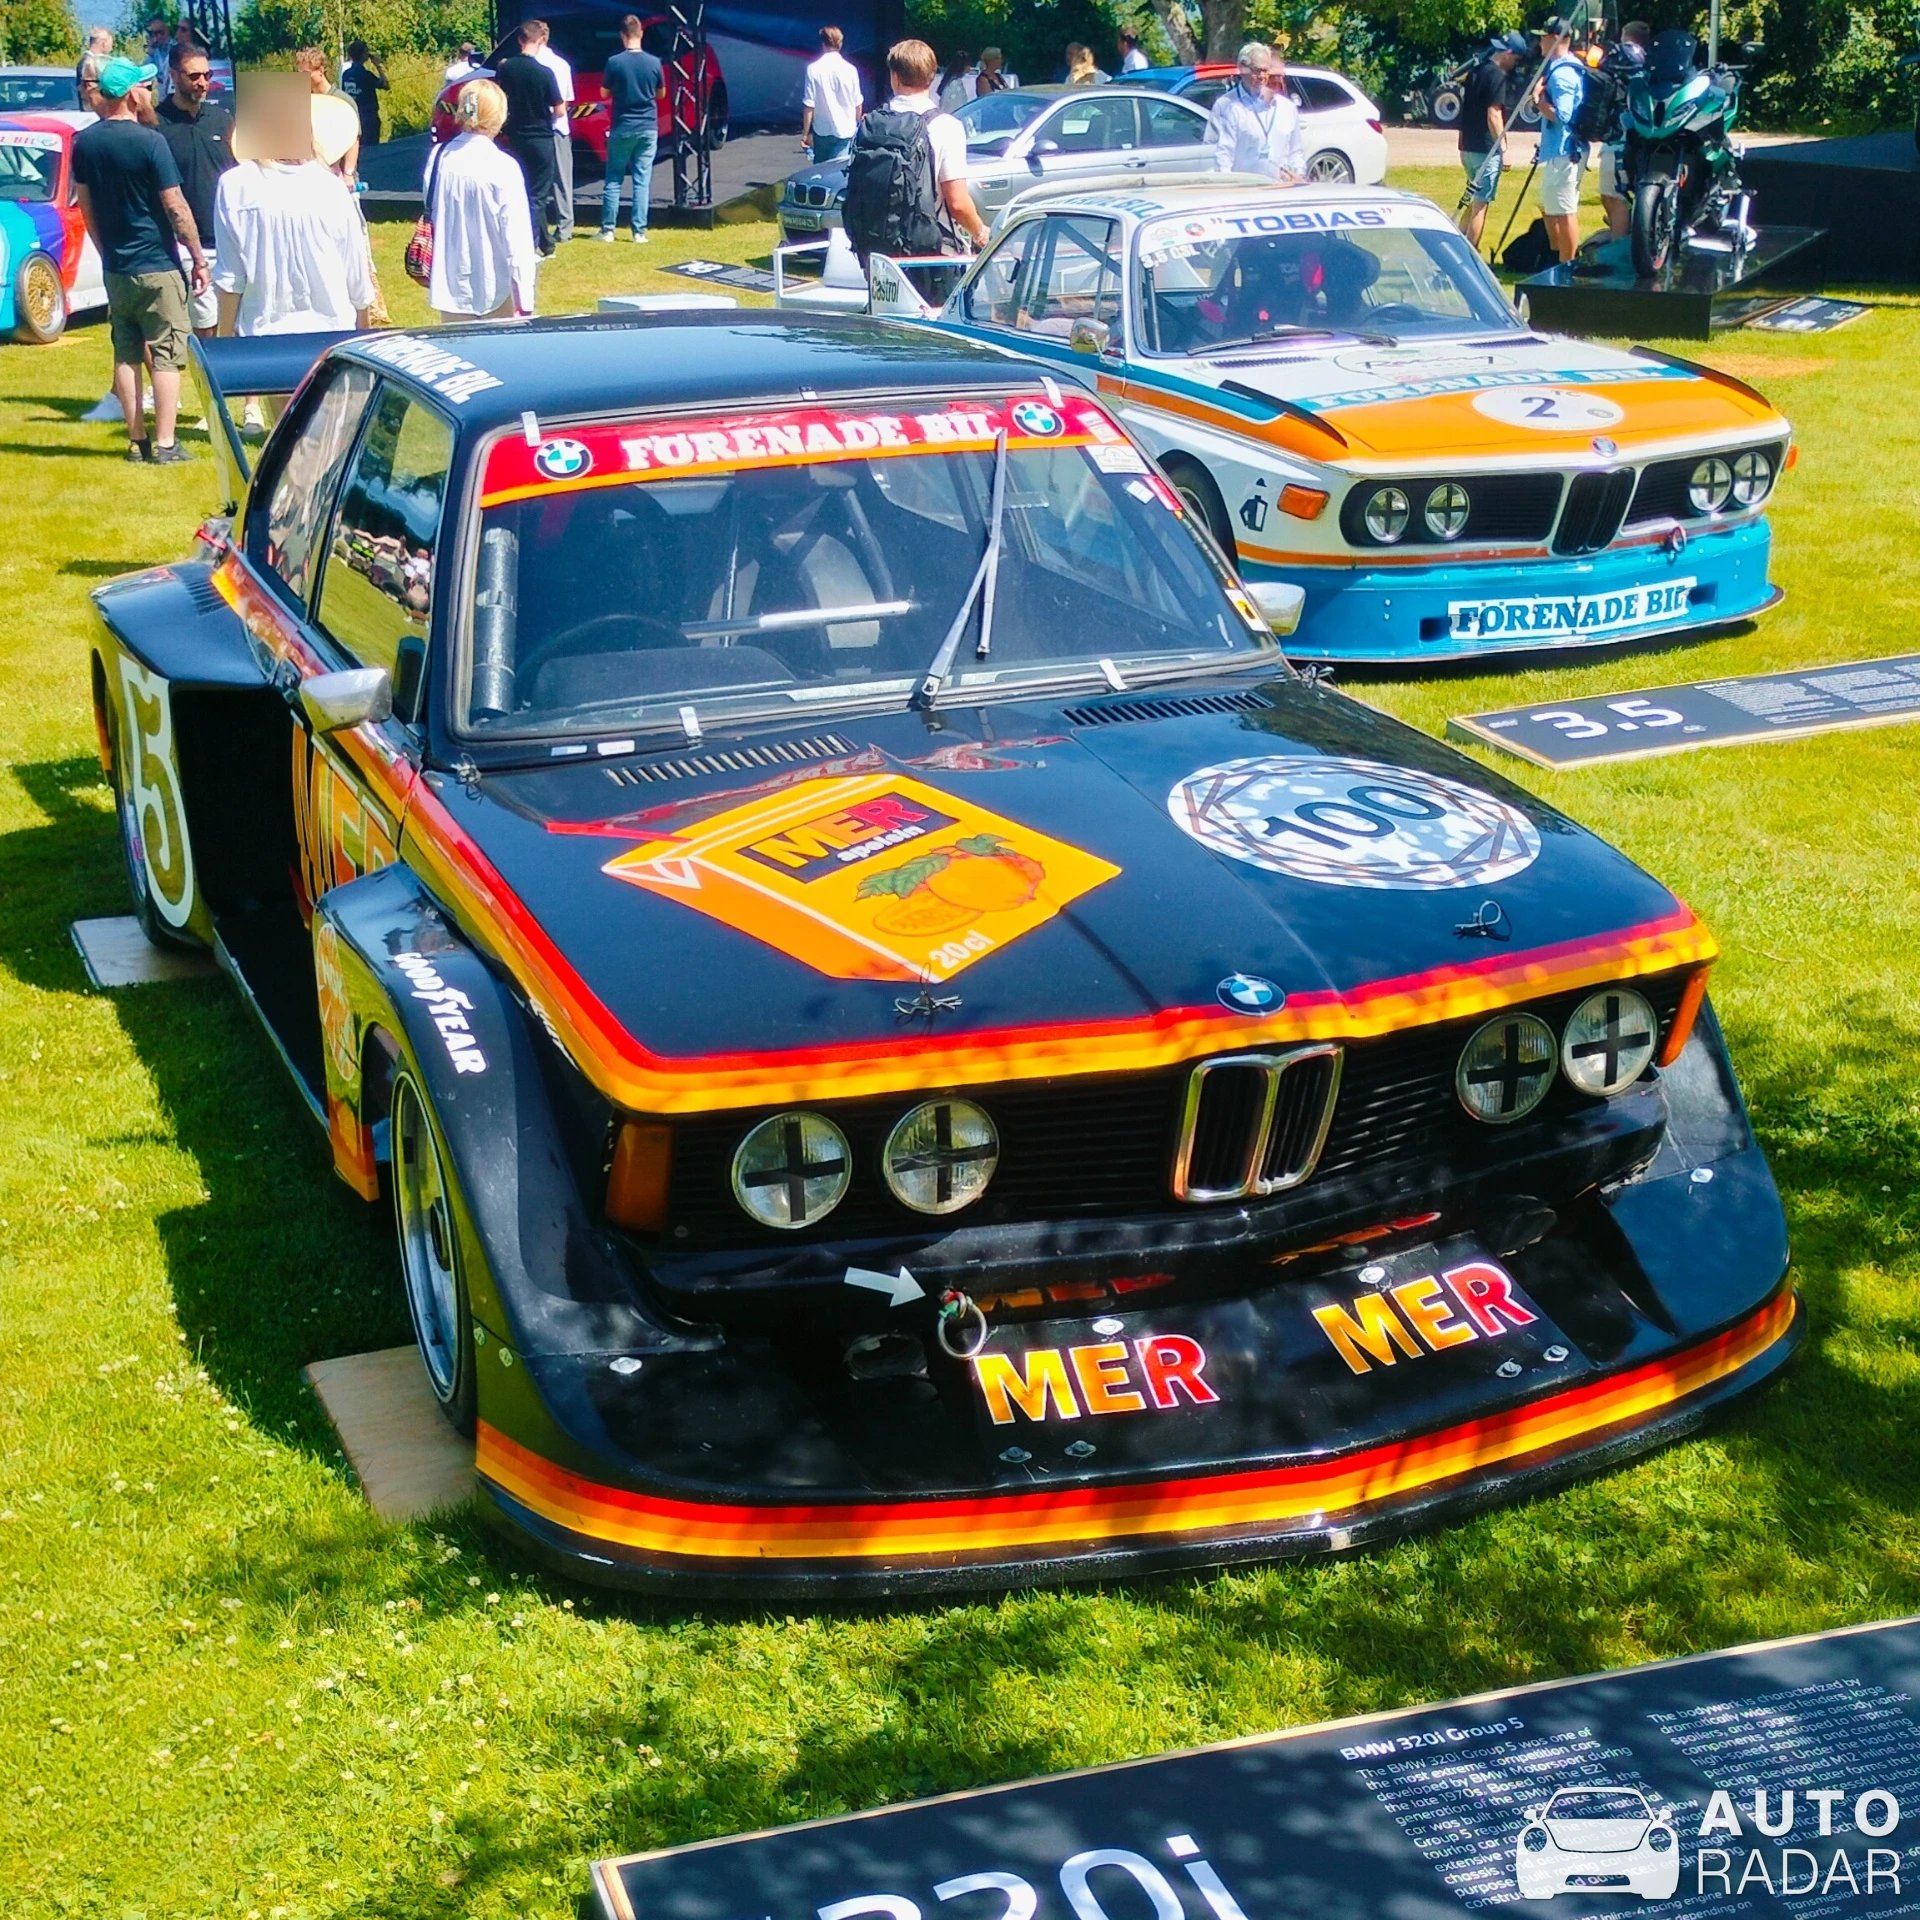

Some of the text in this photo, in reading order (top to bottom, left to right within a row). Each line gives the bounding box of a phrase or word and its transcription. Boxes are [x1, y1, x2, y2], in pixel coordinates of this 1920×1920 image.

[872, 276, 901, 304] Castrol
[433, 369, 504, 405] BIL
[1520, 396, 1560, 418] 2
[917, 412, 1002, 443] BIL
[1645, 584, 1690, 617] BIL
[1530, 699, 1684, 739] 3.5
[750, 798, 929, 870] MER
[1263, 785, 1447, 851] 100
[928, 929, 996, 970] 20cl
[394, 952, 489, 1075] GOODYEAR
[1312, 1261, 1540, 1376] MER
[972, 1333, 1222, 1426] MER
[1650, 1677, 1863, 1723] The bodywork is characterized by
[1661, 1685, 1884, 1734] dramatically widened fenders, large
[1673, 1692, 1911, 1745] spoilers, and aggressive aerodynamic
[1341, 1716, 1524, 1760] BMW 320i Group 5
[1683, 1706, 1903, 1755] components developed to improve
[1691, 1744, 1768, 1765] high-speed
[1769, 1735, 1823, 1750] stability
[1823, 1728, 1849, 1740] and
[1850, 1717, 1913, 1734] cornering
[1356, 1727, 1593, 1778] The BMW 320i Group 5 was one of
[1366, 1741, 1600, 1790] the most extreme competition cars
[1704, 1755, 1793, 1779] performance.
[1792, 1746, 1835, 1759] Under
[1835, 1740, 1859, 1750] the
[1859, 1732, 1895, 1746] hood
[1894, 1730, 1909, 1738] is
[1715, 1758, 1830, 1788] racing-developed
[1830, 1752, 1859, 1764] M12
[1375, 1747, 1634, 1801] developed by BMW Motorsport during
[1384, 1803, 1410, 1812] the
[1411, 1797, 1439, 1807] late
[1487, 1777, 1534, 1793] Based
[1537, 1775, 1555, 1784] on
[1556, 1770, 1580, 1780] the
[1581, 1763, 1607, 1775] E21
[1737, 1782, 1784, 1796] design
[1784, 1774, 1813, 1787] that
[1814, 1769, 1847, 1781] later
[1846, 1761, 1887, 1774] forms
[1886, 1756, 1911, 1766] the
[1396, 1804, 1471, 1826] generation
[1473, 1799, 1489, 1809] of
[1489, 1795, 1514, 1805] the
[1515, 1786, 1554, 1800] BMW
[1567, 1777, 1617, 1790] Series,
[1617, 1771, 1641, 1781] the
[1405, 1826, 1427, 1836] car
[1430, 1820, 1460, 1831] was
[1461, 1812, 1493, 1824] built
[1494, 1810, 1509, 1818] in
[1414, 1834, 1461, 1848] Group
[1461, 1829, 1473, 1838] 5
[1553, 1811, 1576, 1820] for
[1774, 1833, 1801, 1845] and
[1423, 1844, 1477, 1859] touring
[1478, 1839, 1499, 1849] car
[1435, 1852, 1502, 1871] extensive
[1445, 1867, 1504, 1884] chassis,
[1646, 1900, 1684, 1912] racing
[1684, 1892, 1723, 1905] engine
[1737, 1901, 1753, 1909] on
